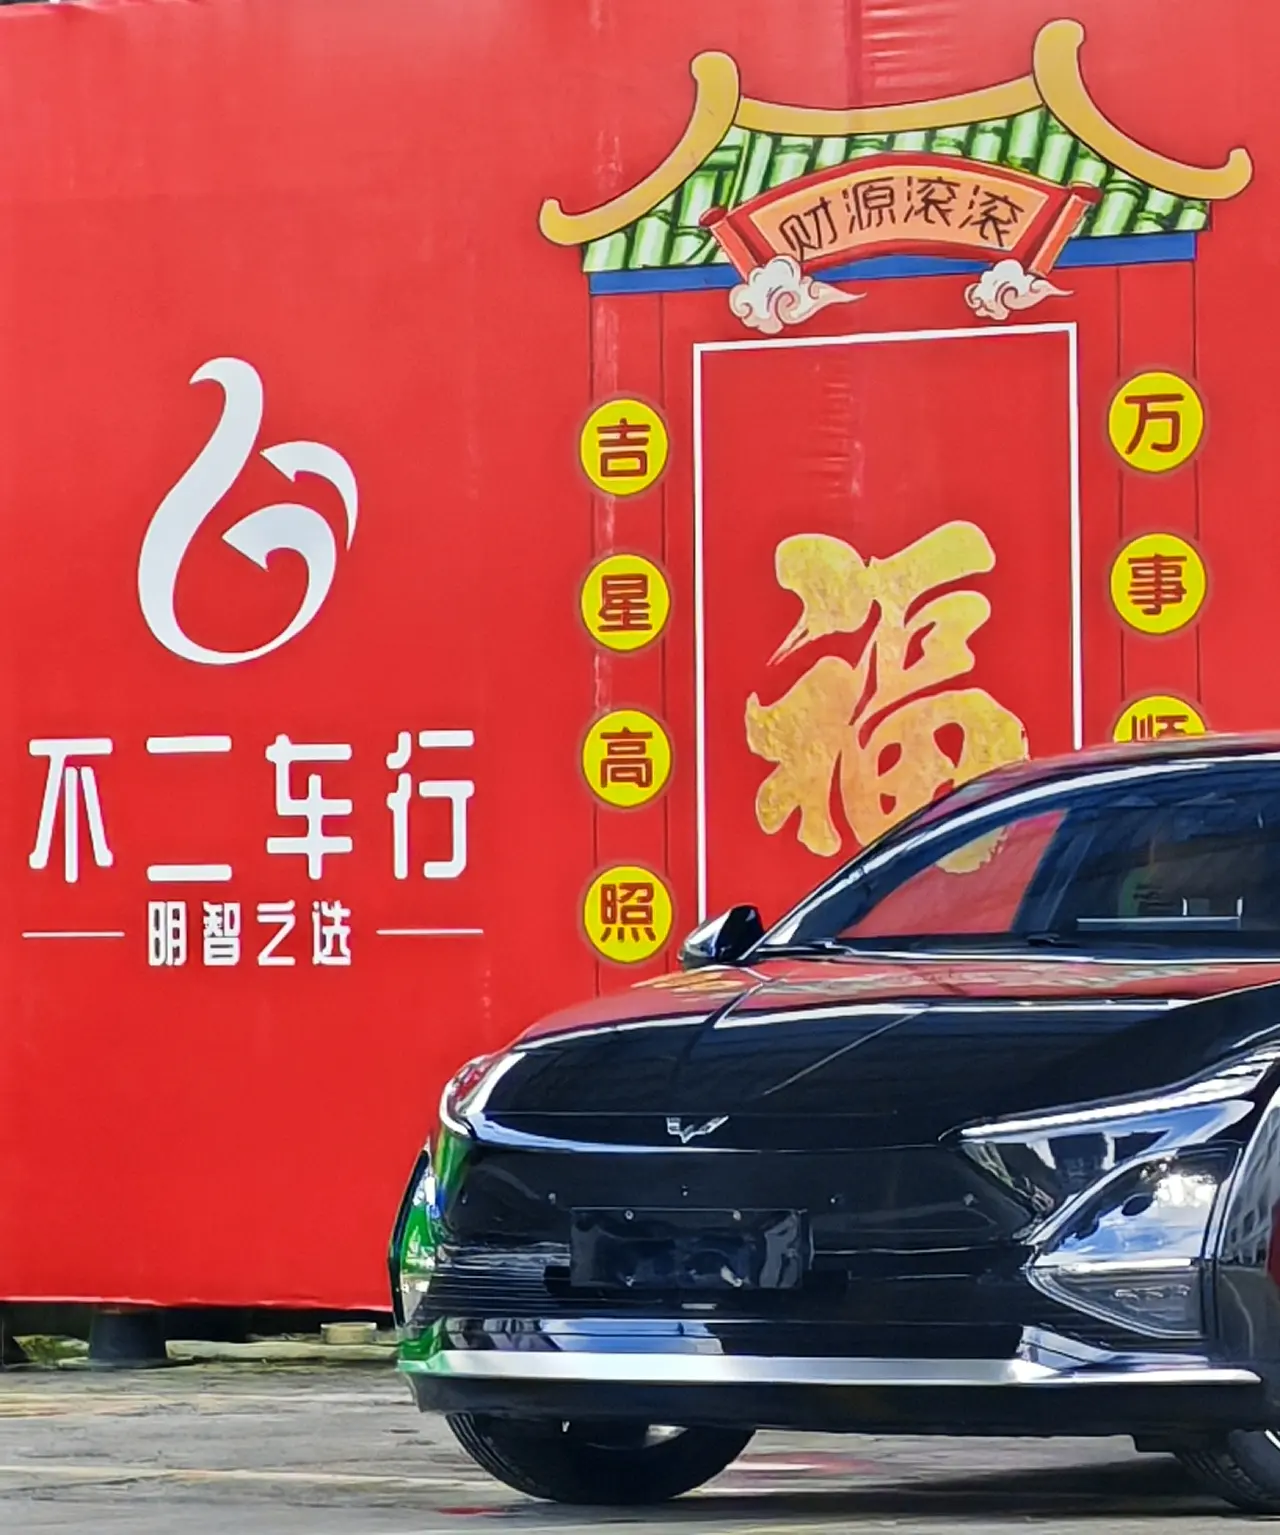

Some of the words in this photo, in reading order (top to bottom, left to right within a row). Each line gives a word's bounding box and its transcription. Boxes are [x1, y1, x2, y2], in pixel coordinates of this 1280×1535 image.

[777, 175, 1026, 262] 财源滚滚
[595, 418, 658, 942] 吉星高照
[745, 520, 1030, 868] 福
[28, 729, 475, 884] 不二车行
[147, 900, 352, 967] 明智之选
